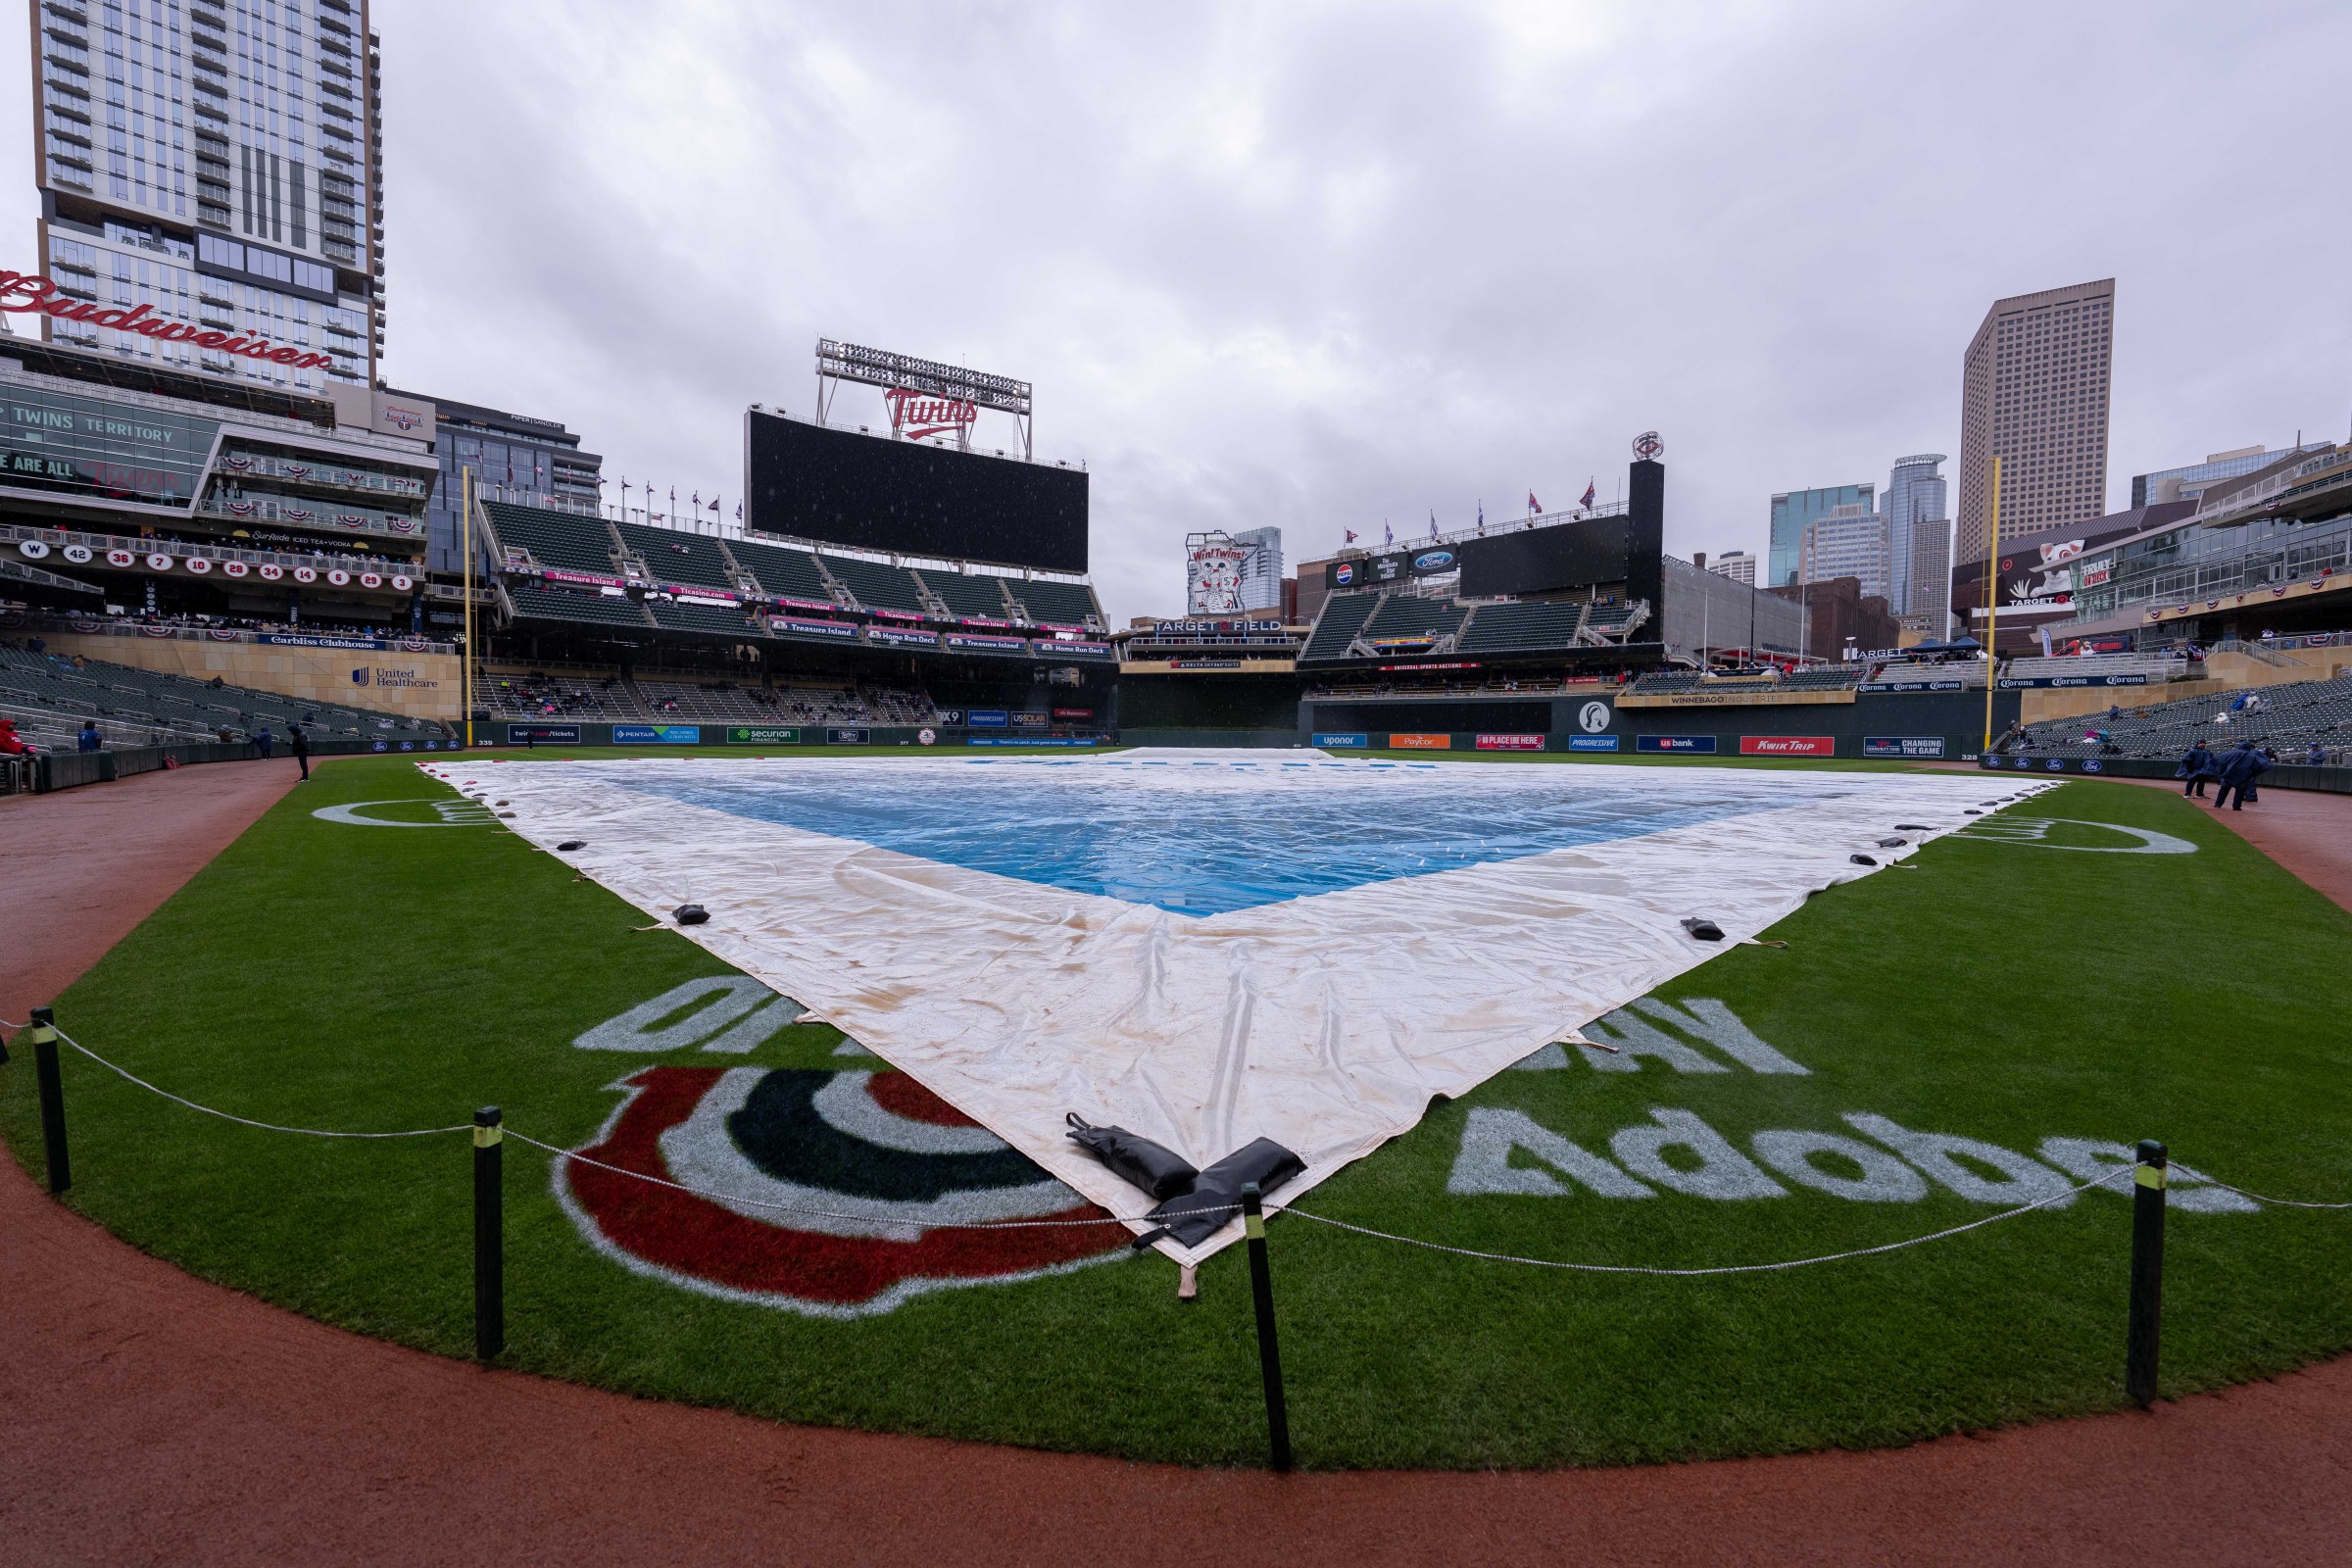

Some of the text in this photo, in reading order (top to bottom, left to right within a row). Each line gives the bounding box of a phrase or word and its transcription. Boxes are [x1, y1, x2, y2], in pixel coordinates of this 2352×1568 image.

[0, 270, 333, 368] Budweiser
[887, 388, 978, 440] Twins
[14, 407, 173, 443] TWINS TERRITORY
[15, 456, 43, 472] ARE
[47, 461, 74, 476] ALL
[252, 530, 290, 542] Surfside
[28, 544, 41, 554] W
[70, 549, 86, 559] 42
[113, 554, 128, 563] 36
[1194, 548, 1246, 561] Win! Twins!
[192, 561, 205, 569] 10
[1422, 555, 1445, 566] Ford
[264, 567, 278, 576] 34
[300, 570, 311, 579] 14
[555, 572, 615, 586] Treasure Island
[786, 600, 809, 609] Treasure
[792, 624, 852, 636] Treasure Island
[1154, 621, 1282, 631] TARGET FIELD
[270, 636, 375, 649] Carbliss Clubhouse
[376, 668, 415, 678] United
[376, 678, 438, 688] Healthcare
[2001, 679, 2034, 688] Corona
[2052, 677, 2087, 686] Corona
[2107, 675, 2144, 685] Corona
[1859, 684, 1886, 693] Corona
[1893, 683, 1922, 692] Corona
[1930, 681, 1959, 691] Corona
[952, 711, 958, 721] 9
[1324, 737, 1354, 746] uponor
[1404, 737, 1434, 747] Paycor
[1446, 1107, 2262, 1213] Adobe
